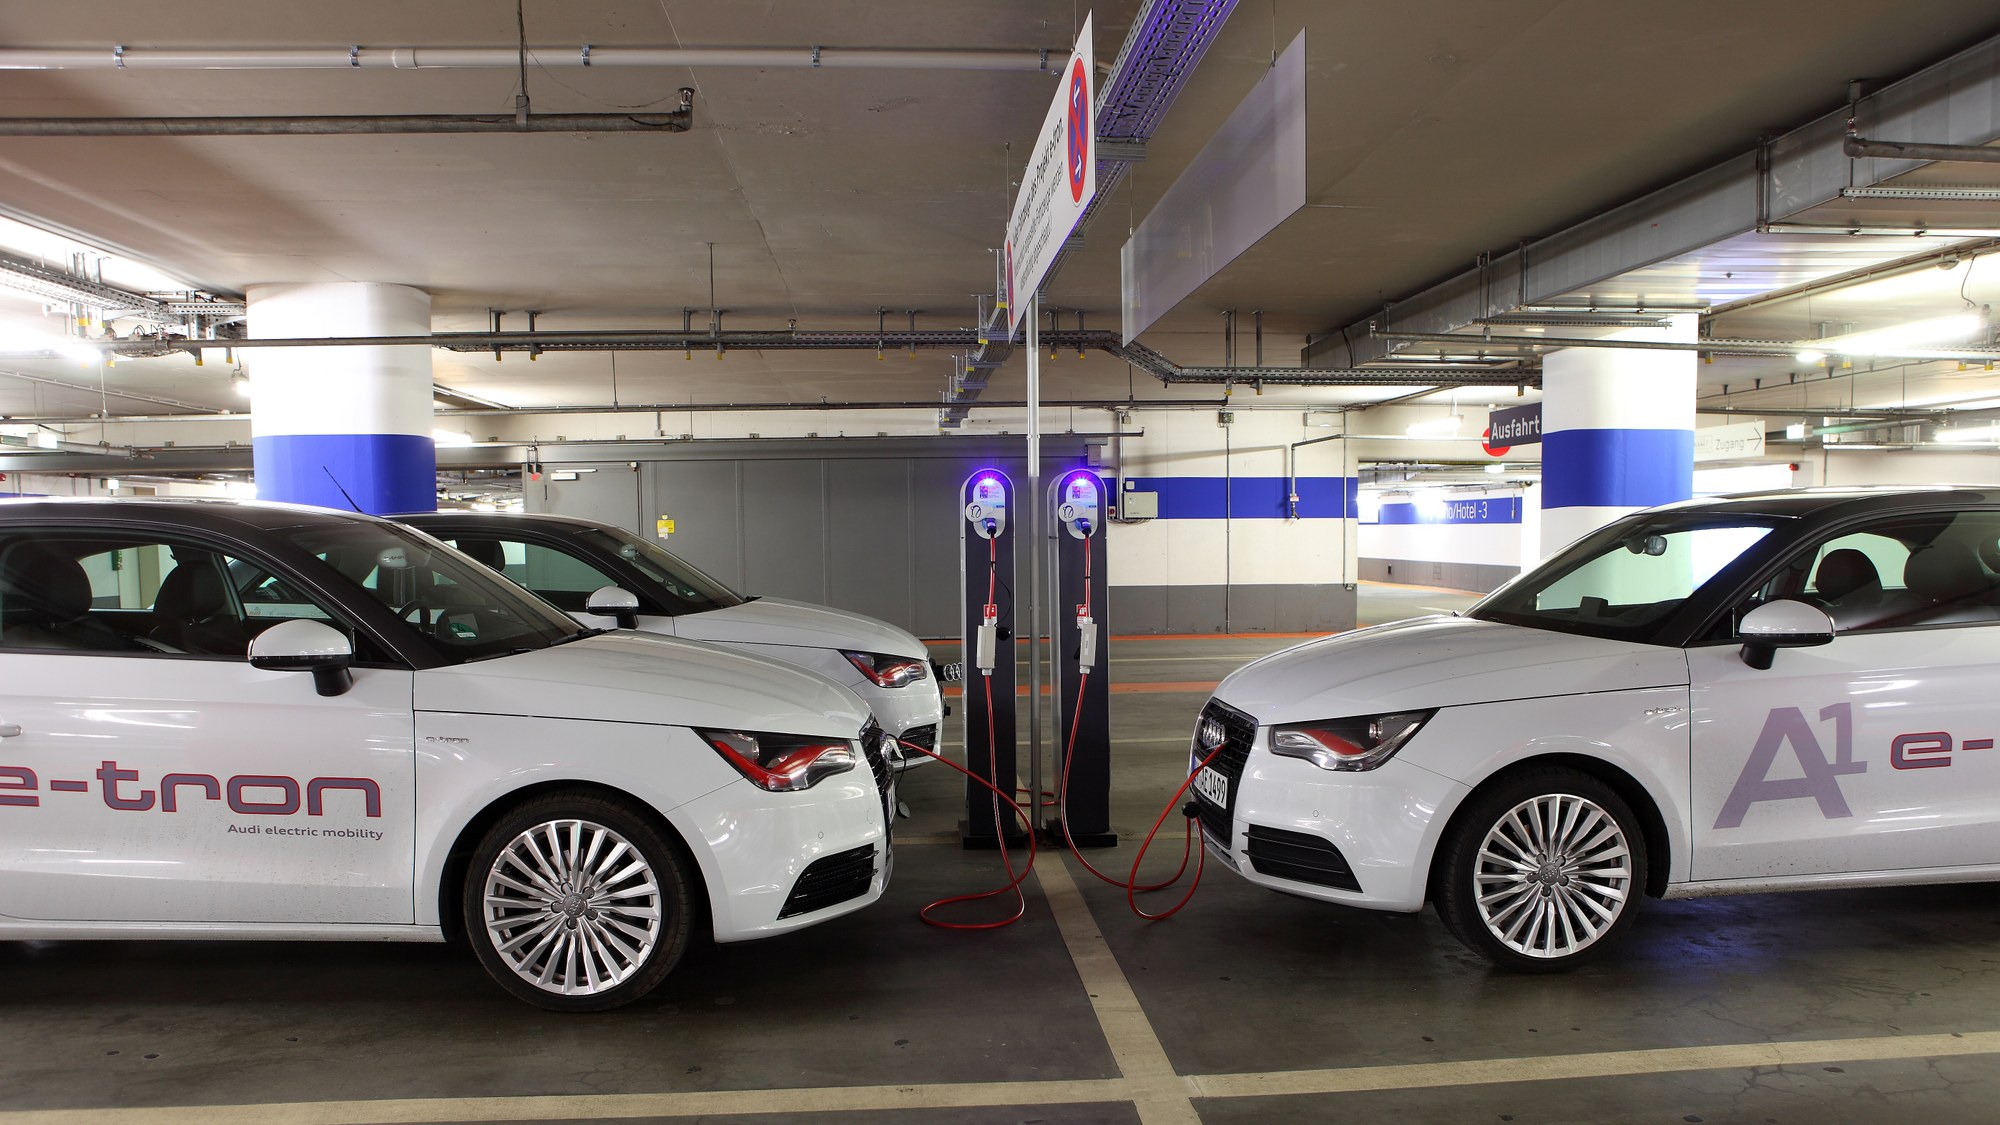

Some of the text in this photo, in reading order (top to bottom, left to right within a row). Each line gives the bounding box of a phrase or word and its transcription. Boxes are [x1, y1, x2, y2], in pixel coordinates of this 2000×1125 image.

[1491, 415, 1540, 441] Ausfahrt
[1715, 439, 1744, 452] Zugang
[1478, 501, 1488, 519] -3
[1712, 702, 1868, 829] A1
[0, 760, 382, 818] e-tron
[227, 824, 384, 841] Audi electric mobility
